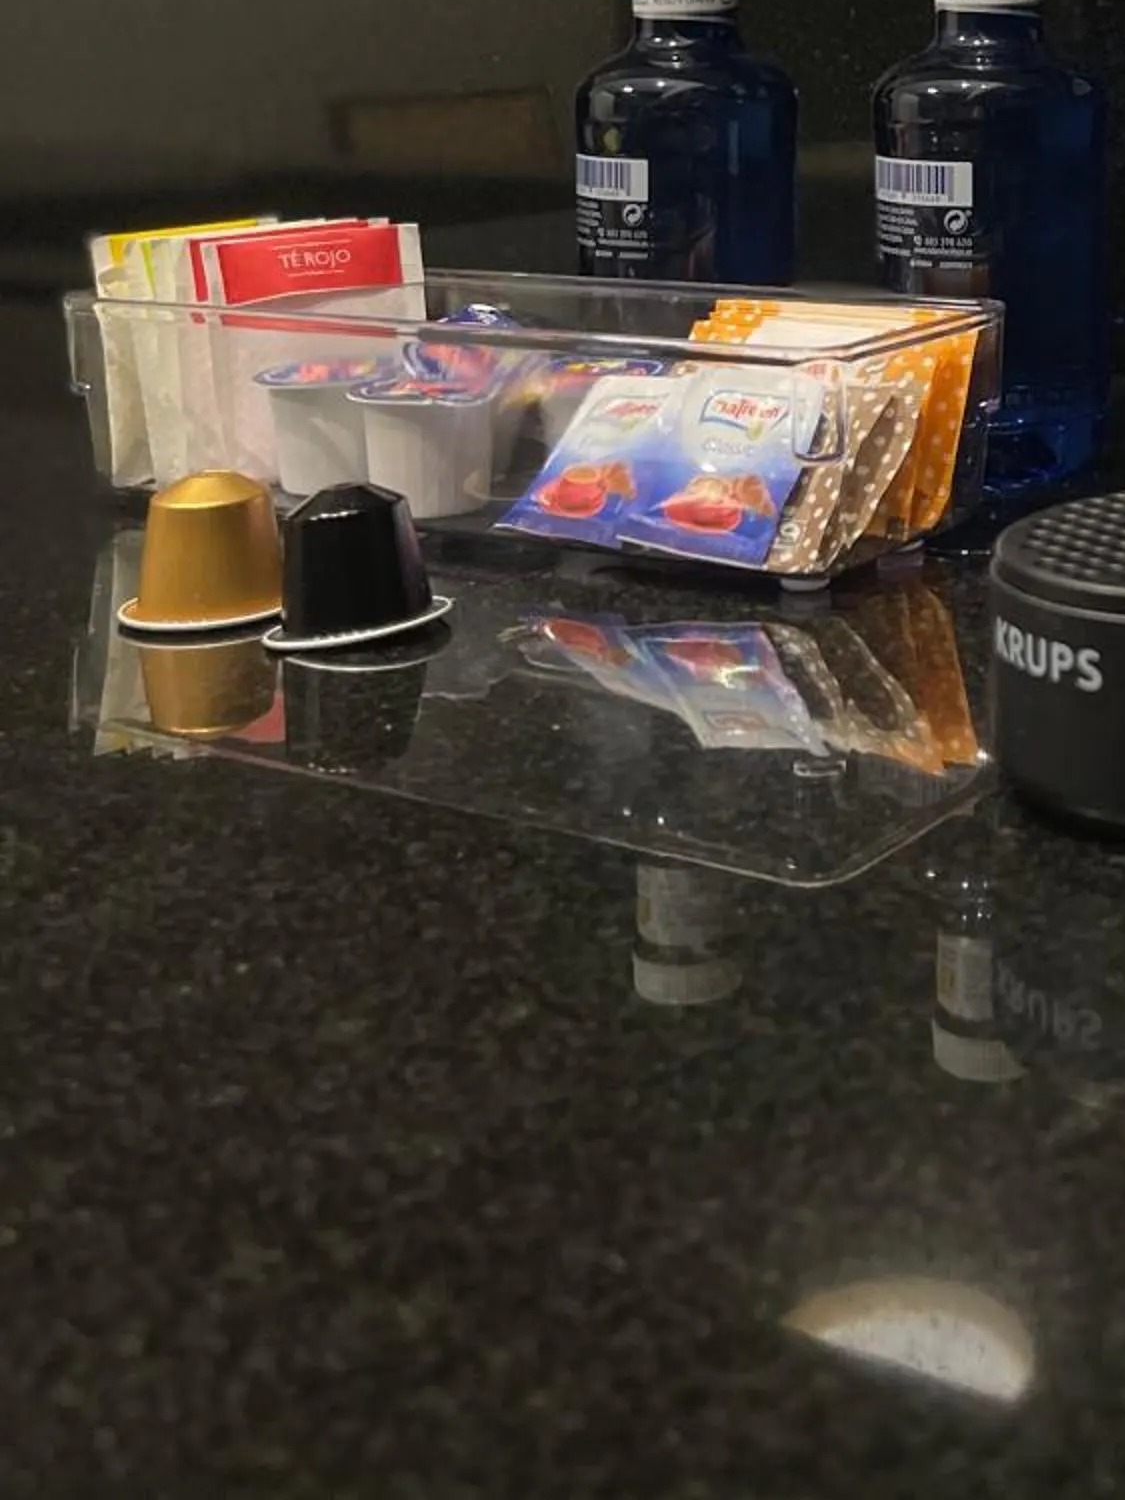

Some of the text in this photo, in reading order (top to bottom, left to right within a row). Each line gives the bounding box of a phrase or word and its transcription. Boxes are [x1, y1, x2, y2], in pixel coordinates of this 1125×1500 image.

[276, 248, 351, 269] TÉ ROJO
[995, 615, 1103, 692] KRUPS
